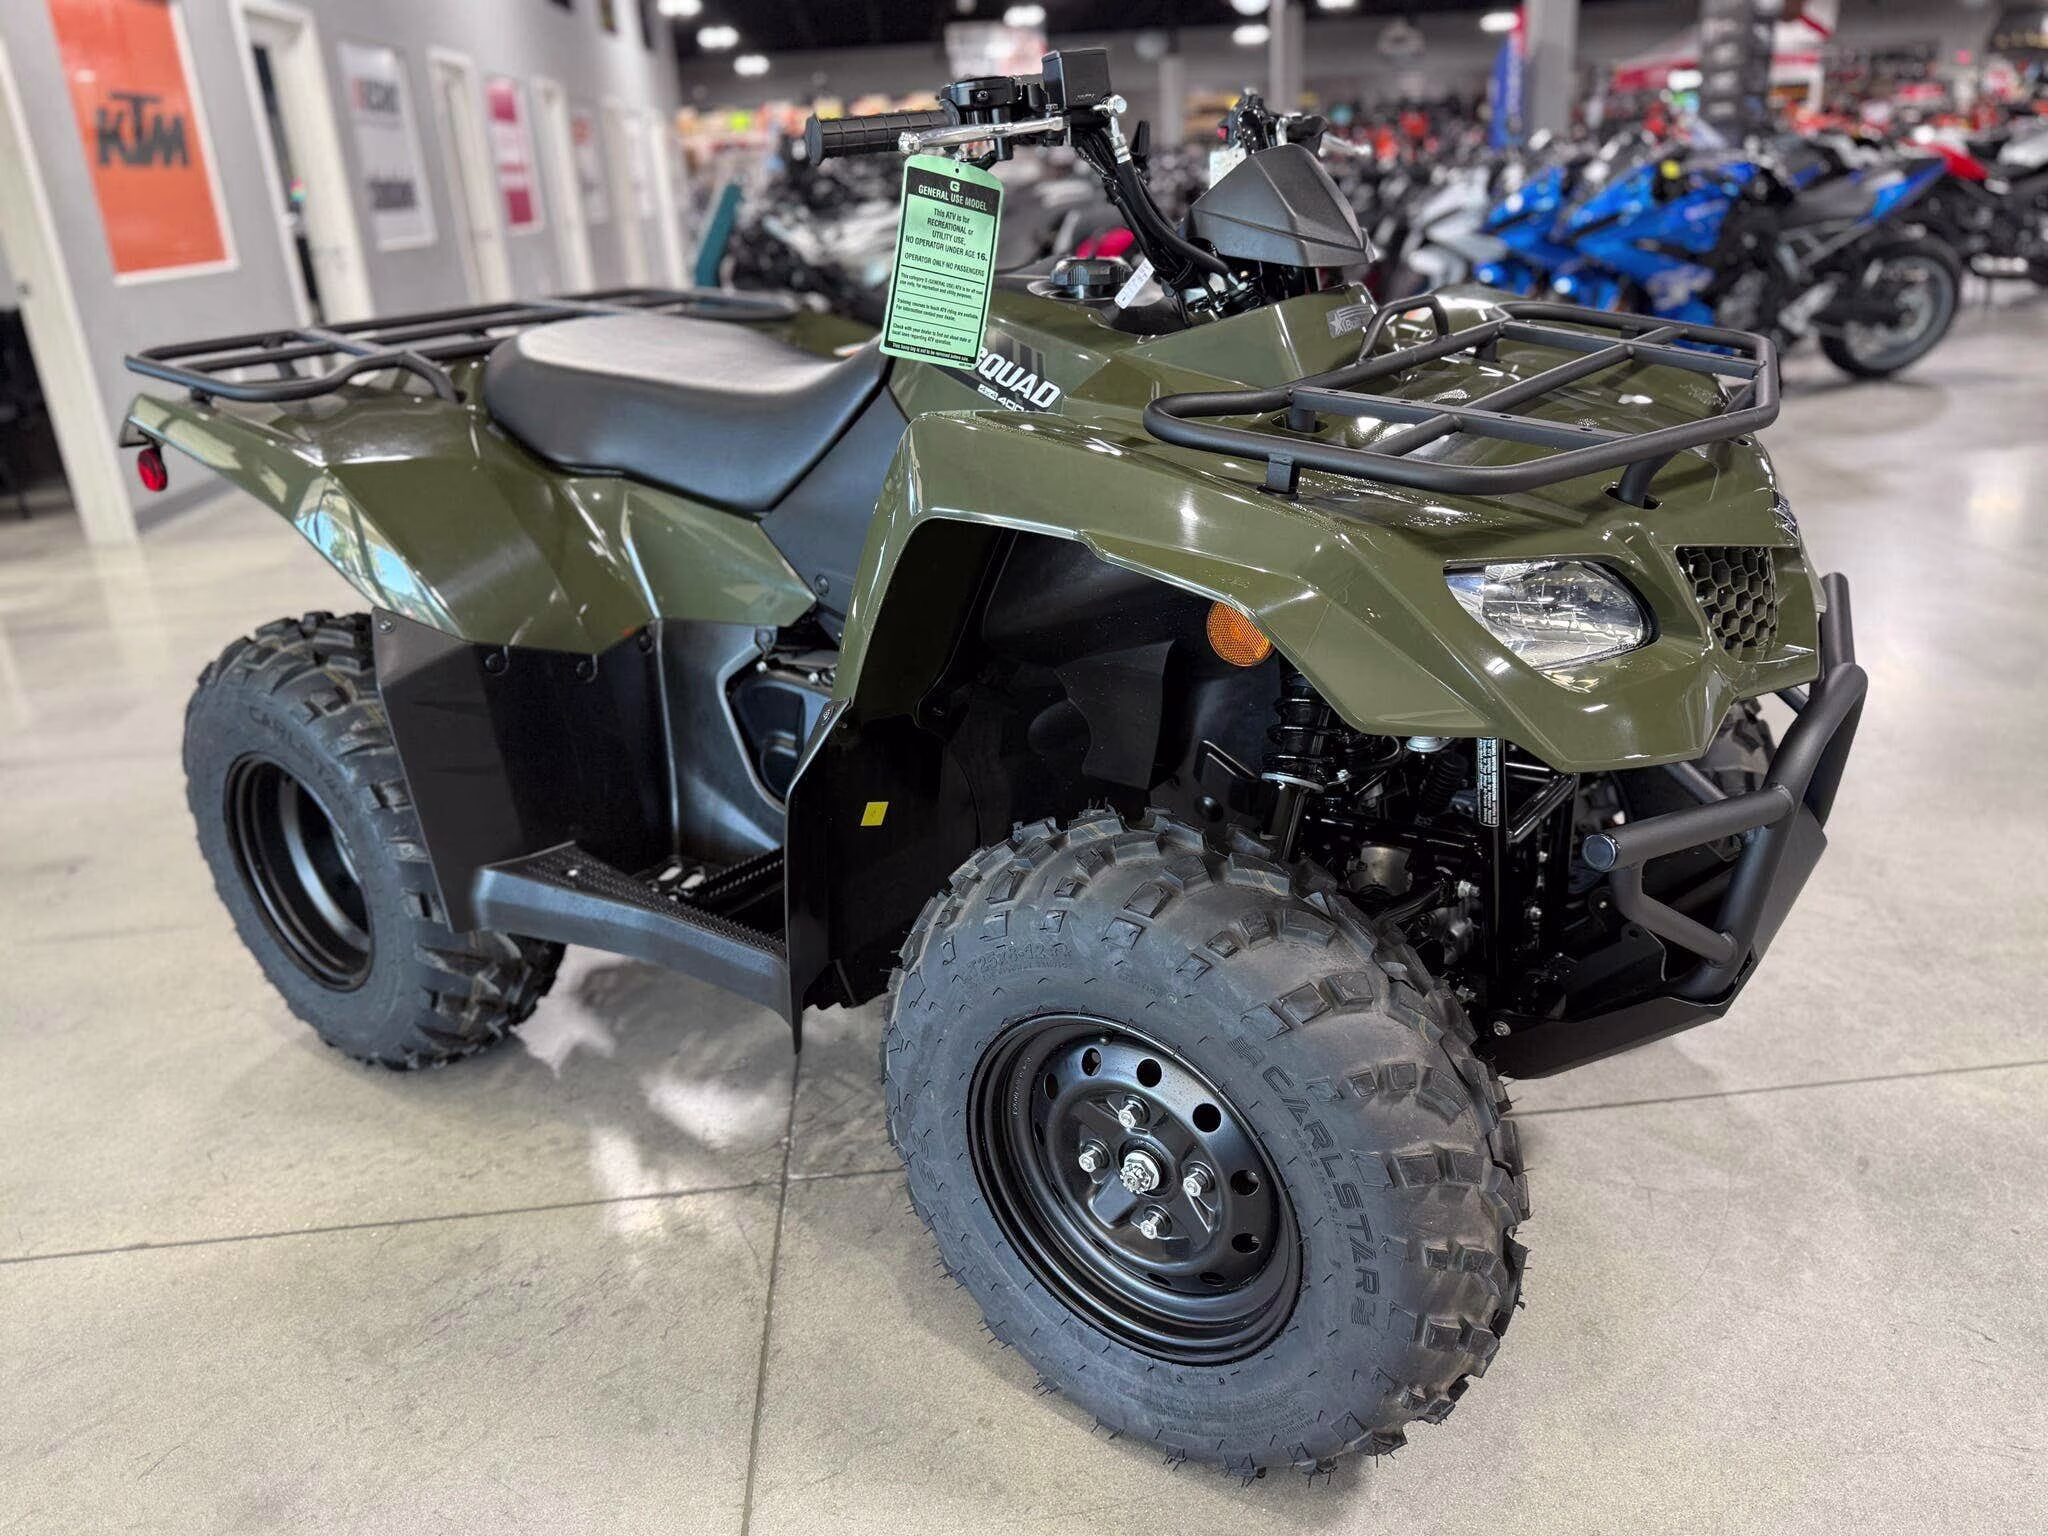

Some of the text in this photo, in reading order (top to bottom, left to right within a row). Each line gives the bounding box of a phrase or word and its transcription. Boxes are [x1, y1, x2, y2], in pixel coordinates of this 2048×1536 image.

[95, 90, 191, 166] KTM
[918, 184, 989, 211] GENERAL USE MODEL
[950, 180, 961, 193] G
[927, 217, 968, 234] RECREATIONAL
[934, 208, 945, 218] This
[946, 212, 957, 221] ATV
[905, 235, 989, 261] NO OPERATOR UNDER AGE 16.
[932, 230, 954, 242] UTILITY
[905, 252, 985, 277] OPERATOR ONLY NO PASSENGERS
[1262, 1064, 1380, 1296] CARLSTAR
